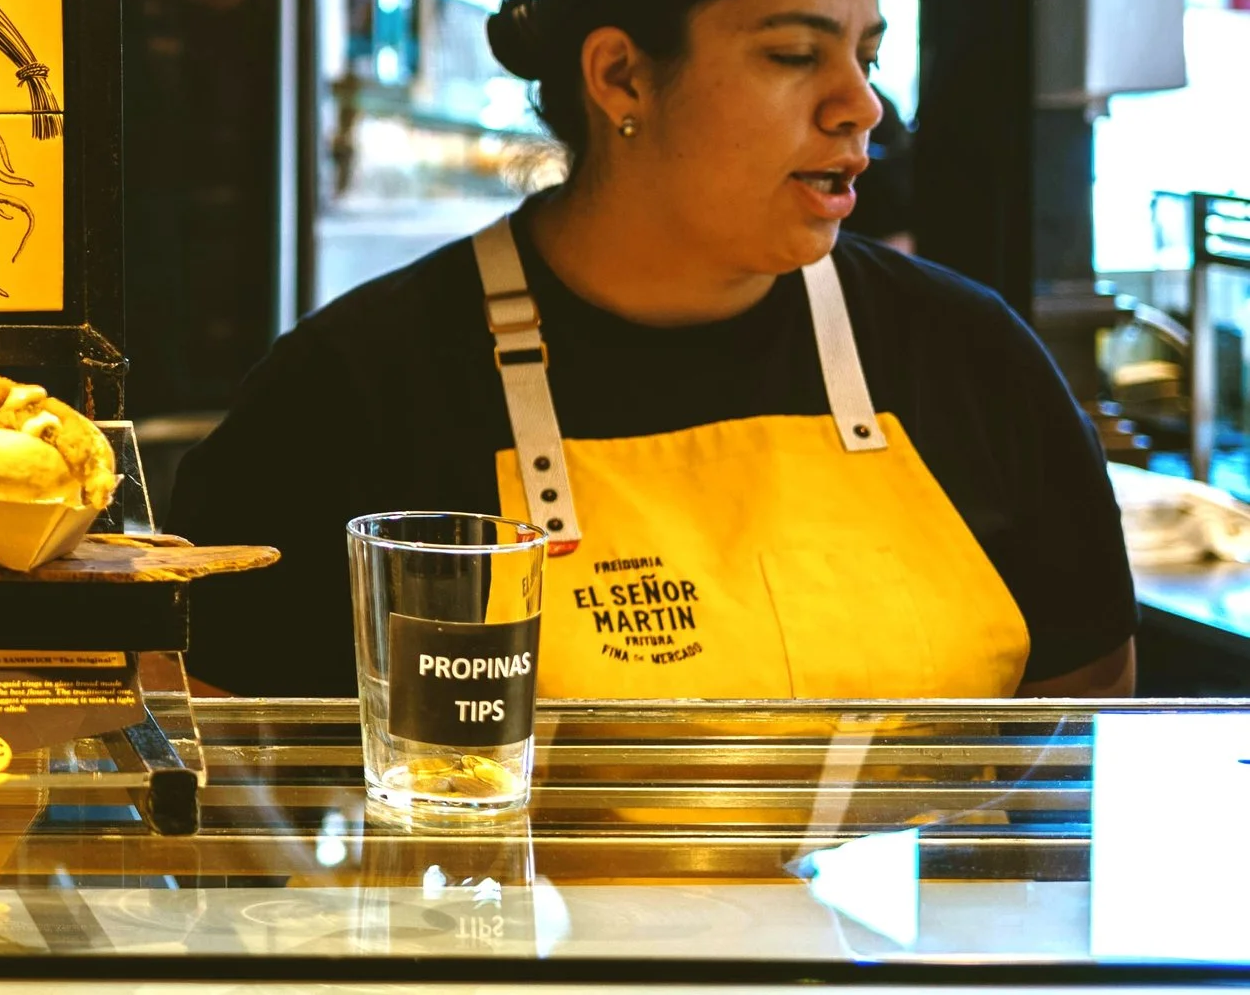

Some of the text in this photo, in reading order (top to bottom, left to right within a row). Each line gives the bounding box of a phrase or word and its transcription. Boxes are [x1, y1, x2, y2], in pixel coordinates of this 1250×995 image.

[573, 574, 698, 608] EL SEÑOR
[592, 606, 696, 632] MARTIN
[625, 635, 674, 646] FRITURA
[602, 643, 629, 662] FINA
[651, 642, 702, 664] MERCADO
[419, 652, 531, 679] PROPINAS
[454, 699, 505, 722] TIPS
